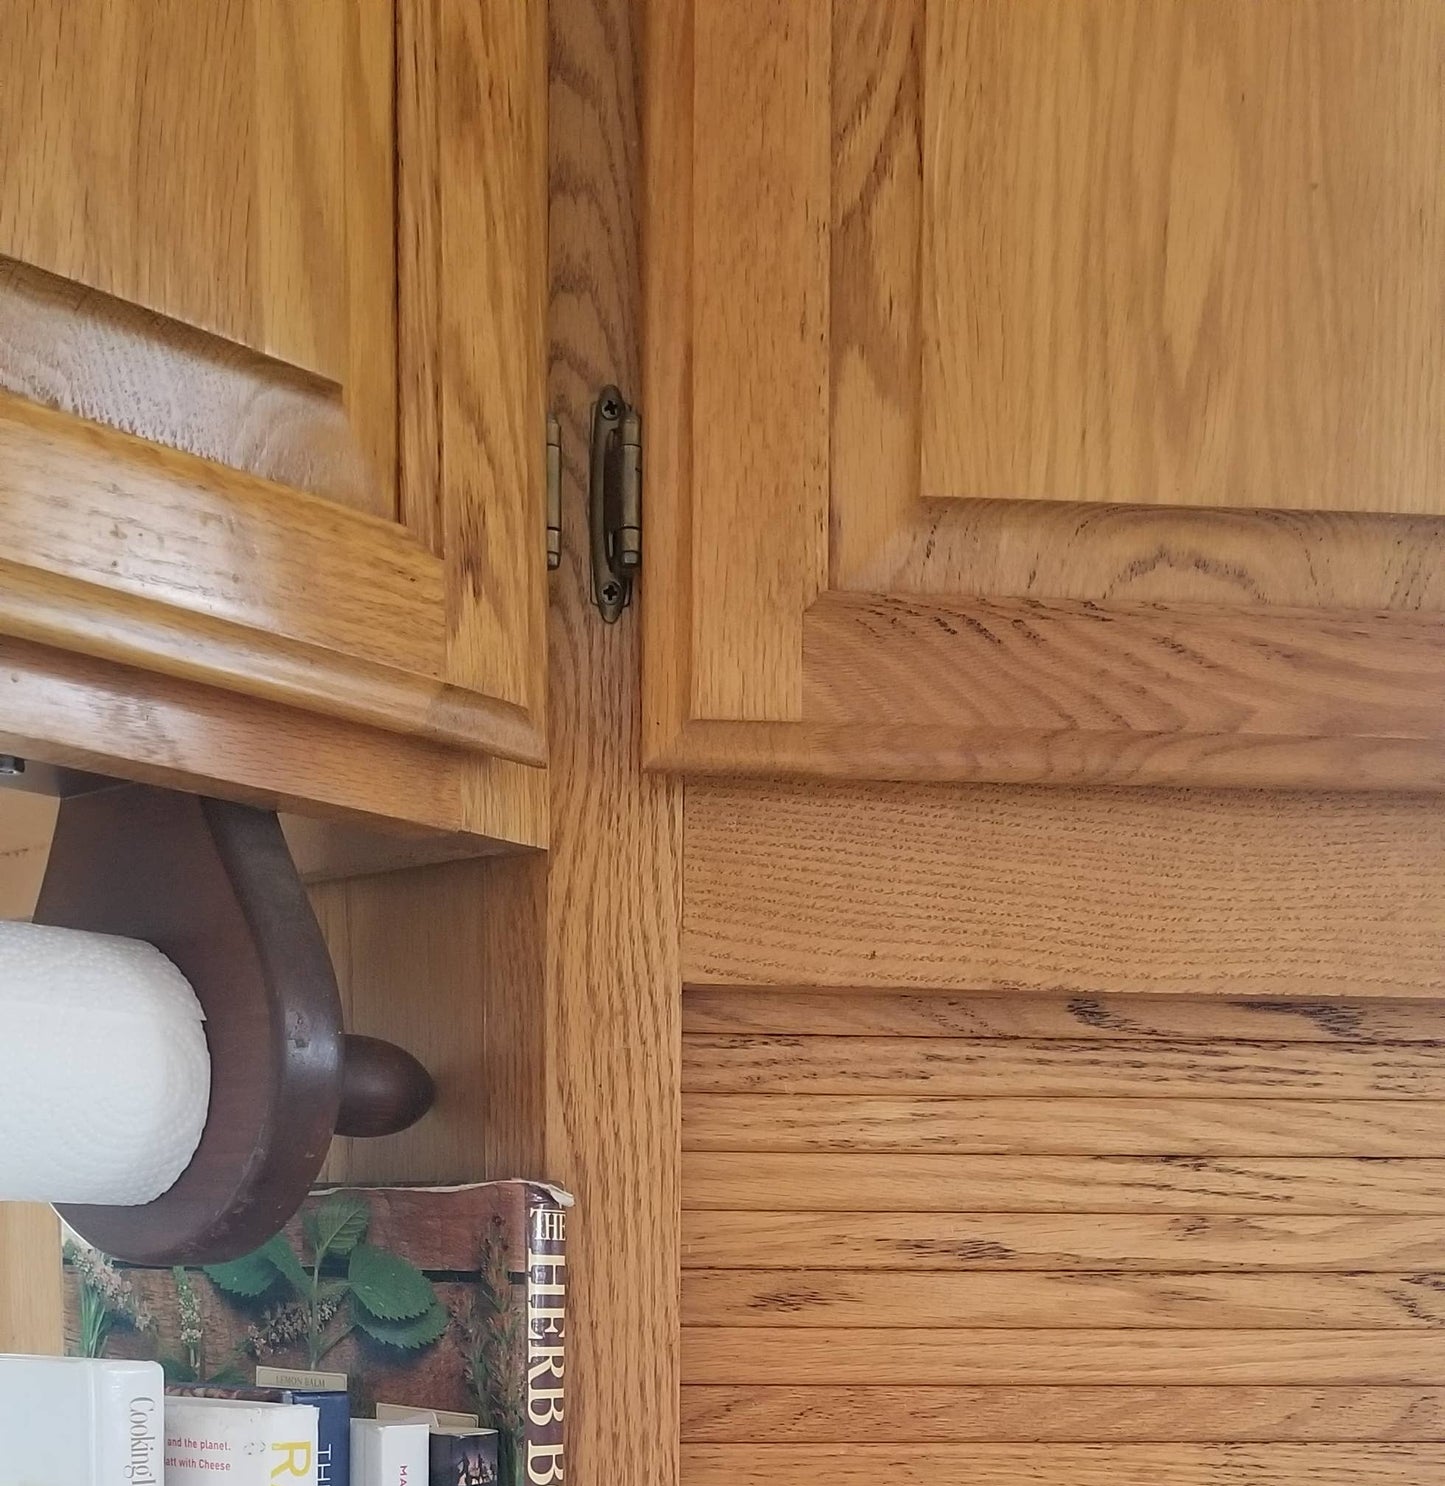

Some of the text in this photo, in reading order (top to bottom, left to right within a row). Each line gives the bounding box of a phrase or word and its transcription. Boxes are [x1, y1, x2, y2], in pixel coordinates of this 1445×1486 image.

[530, 1207, 566, 1242] THE
[528, 1247, 566, 1427] HERB
[167, 1438, 231, 1451] and the planet.
[164, 1457, 231, 1471] att with Cheese
